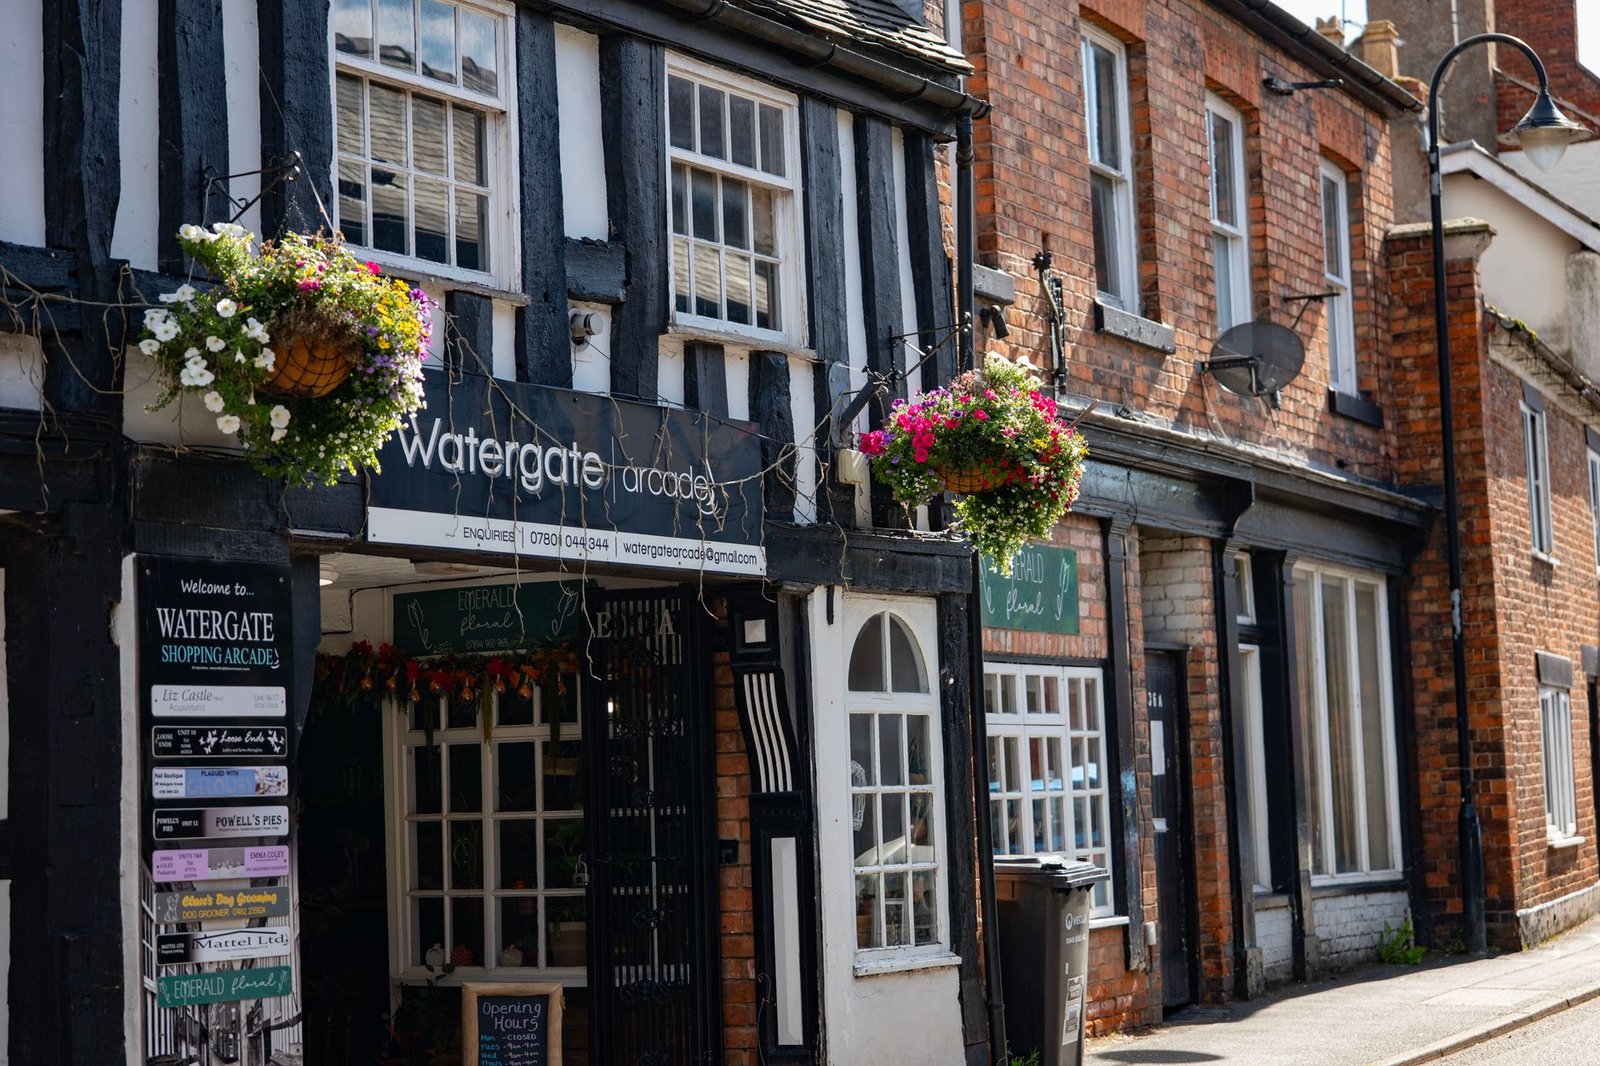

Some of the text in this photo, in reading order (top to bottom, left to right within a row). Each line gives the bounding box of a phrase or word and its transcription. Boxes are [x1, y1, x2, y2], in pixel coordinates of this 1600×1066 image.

[397, 416, 710, 502] Watergate arcade
[463, 526, 758, 566] ENQUIRIES 0780 044 344 watergatearcade@gmail.com
[181, 578, 255, 597] Welcome to...
[458, 587, 515, 611] EMERALD
[1006, 588, 1045, 620] floral
[156, 607, 275, 642] WATERGATE
[460, 612, 514, 636] floral
[161, 644, 273, 666] SHOPPING ARCADE
[162, 688, 178, 702] Liz
[181, 688, 213, 702] Castle
[1147, 691, 1163, 708] 36A
[157, 733, 174, 741] LOOSE
[158, 741, 172, 749] ENDS
[219, 730, 265, 743] Loose Ends
[226, 769, 240, 777] WITH
[215, 813, 283, 828] POWELL'S PIES
[250, 850, 285, 860] EMMA COLEY
[215, 892, 235, 907] Dog
[236, 891, 278, 906] Grooming
[182, 911, 198, 919] DOG
[198, 908, 230, 919] GROOMER
[195, 936, 252, 949] Mattel
[258, 933, 285, 945] Ltd
[174, 972, 277, 1000] EMERALD floral
[482, 1002, 541, 1019] Opening
[494, 1015, 539, 1032] Hours
